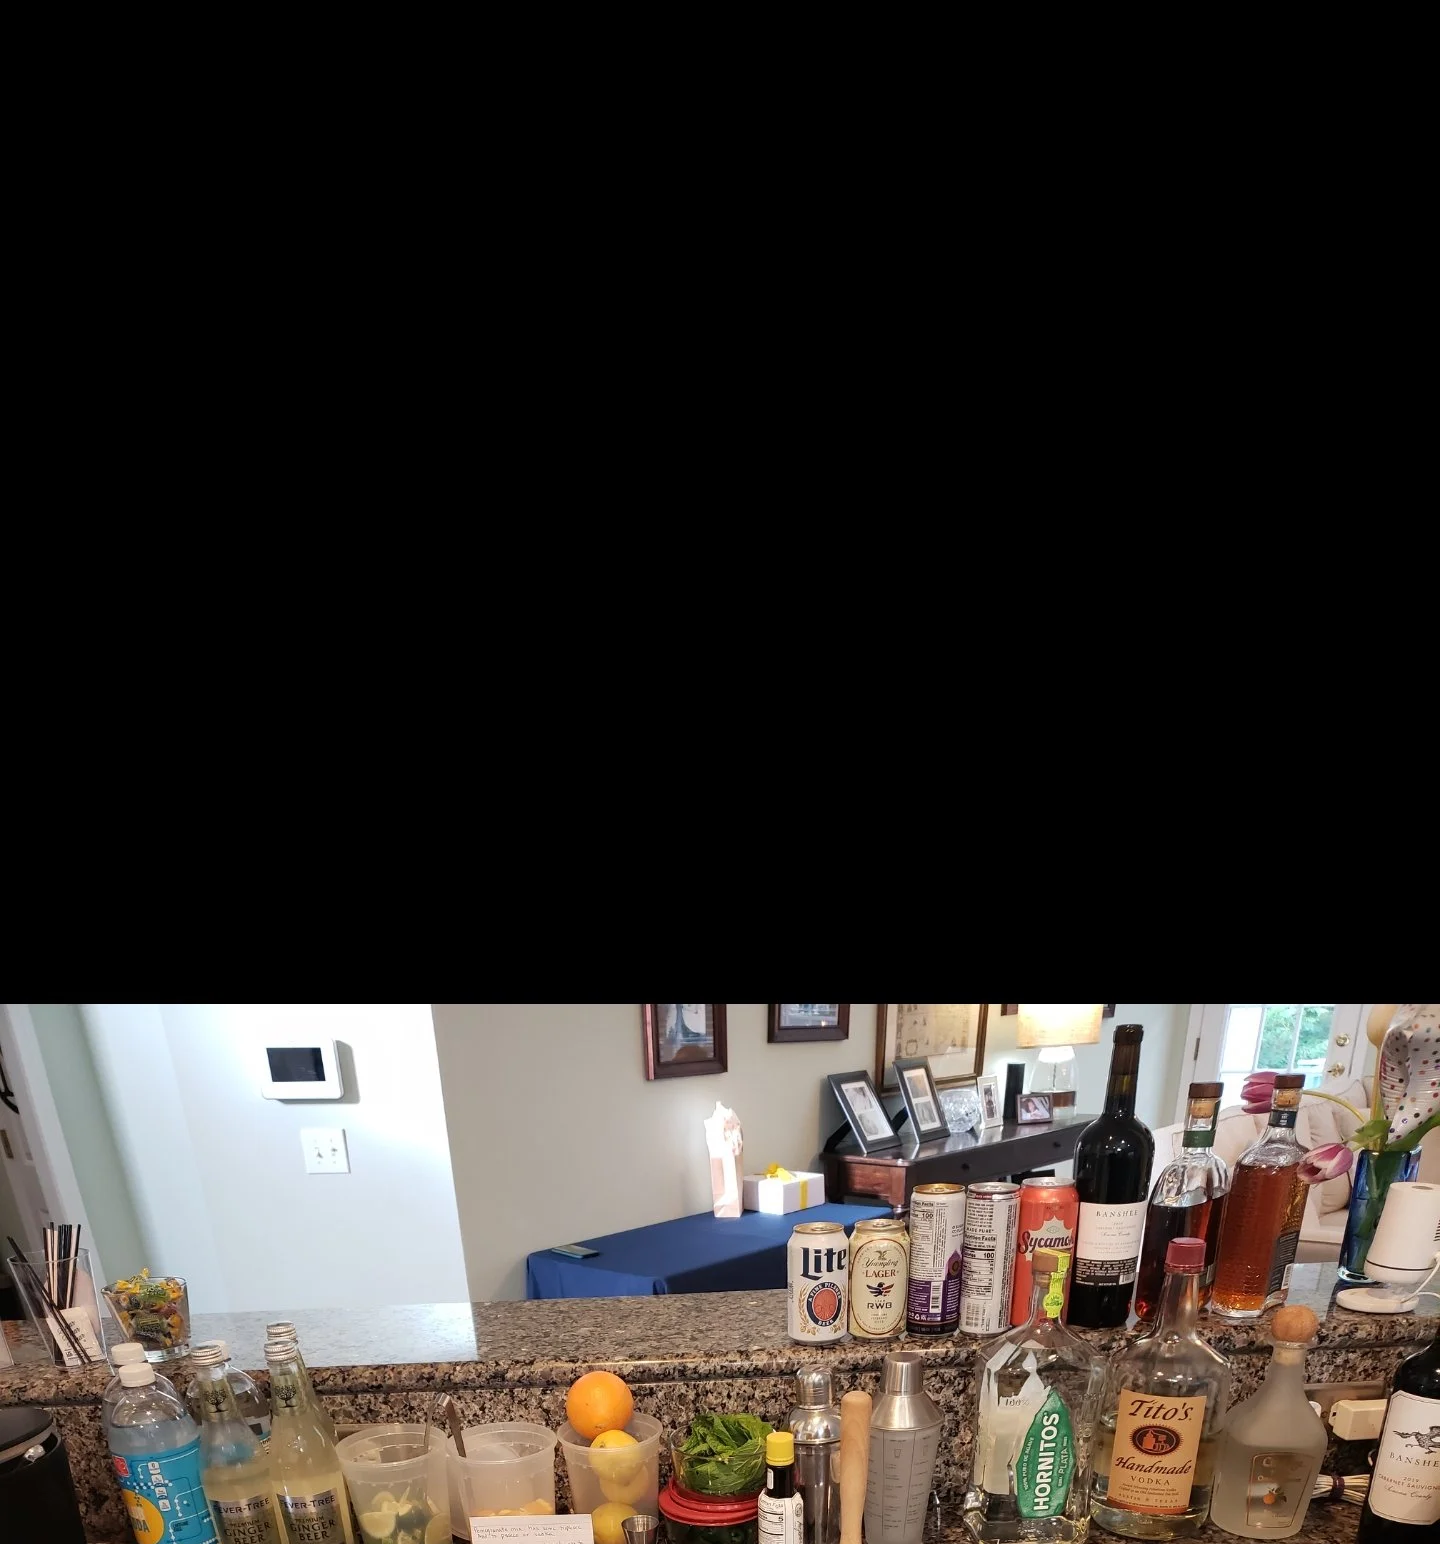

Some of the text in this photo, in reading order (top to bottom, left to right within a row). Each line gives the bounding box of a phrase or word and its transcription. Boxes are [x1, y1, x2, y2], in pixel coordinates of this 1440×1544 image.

[1096, 1209, 1139, 1218] BANSHEE
[800, 1247, 847, 1280] Lite
[862, 1257, 899, 1268] Yuengling
[865, 1270, 896, 1278] LAGER
[1128, 1399, 1194, 1420] Tito's
[1033, 1413, 1059, 1511] HORNITOS
[1058, 1447, 1069, 1474] PLATA
[1115, 1456, 1192, 1475] Handmade
[1130, 1475, 1171, 1486] VODKA
[1378, 1473, 1404, 1487] CABERNET
[223, 1521, 272, 1538] GINGER
[290, 1519, 336, 1533] GINGER
[299, 1531, 330, 1541] BEER
